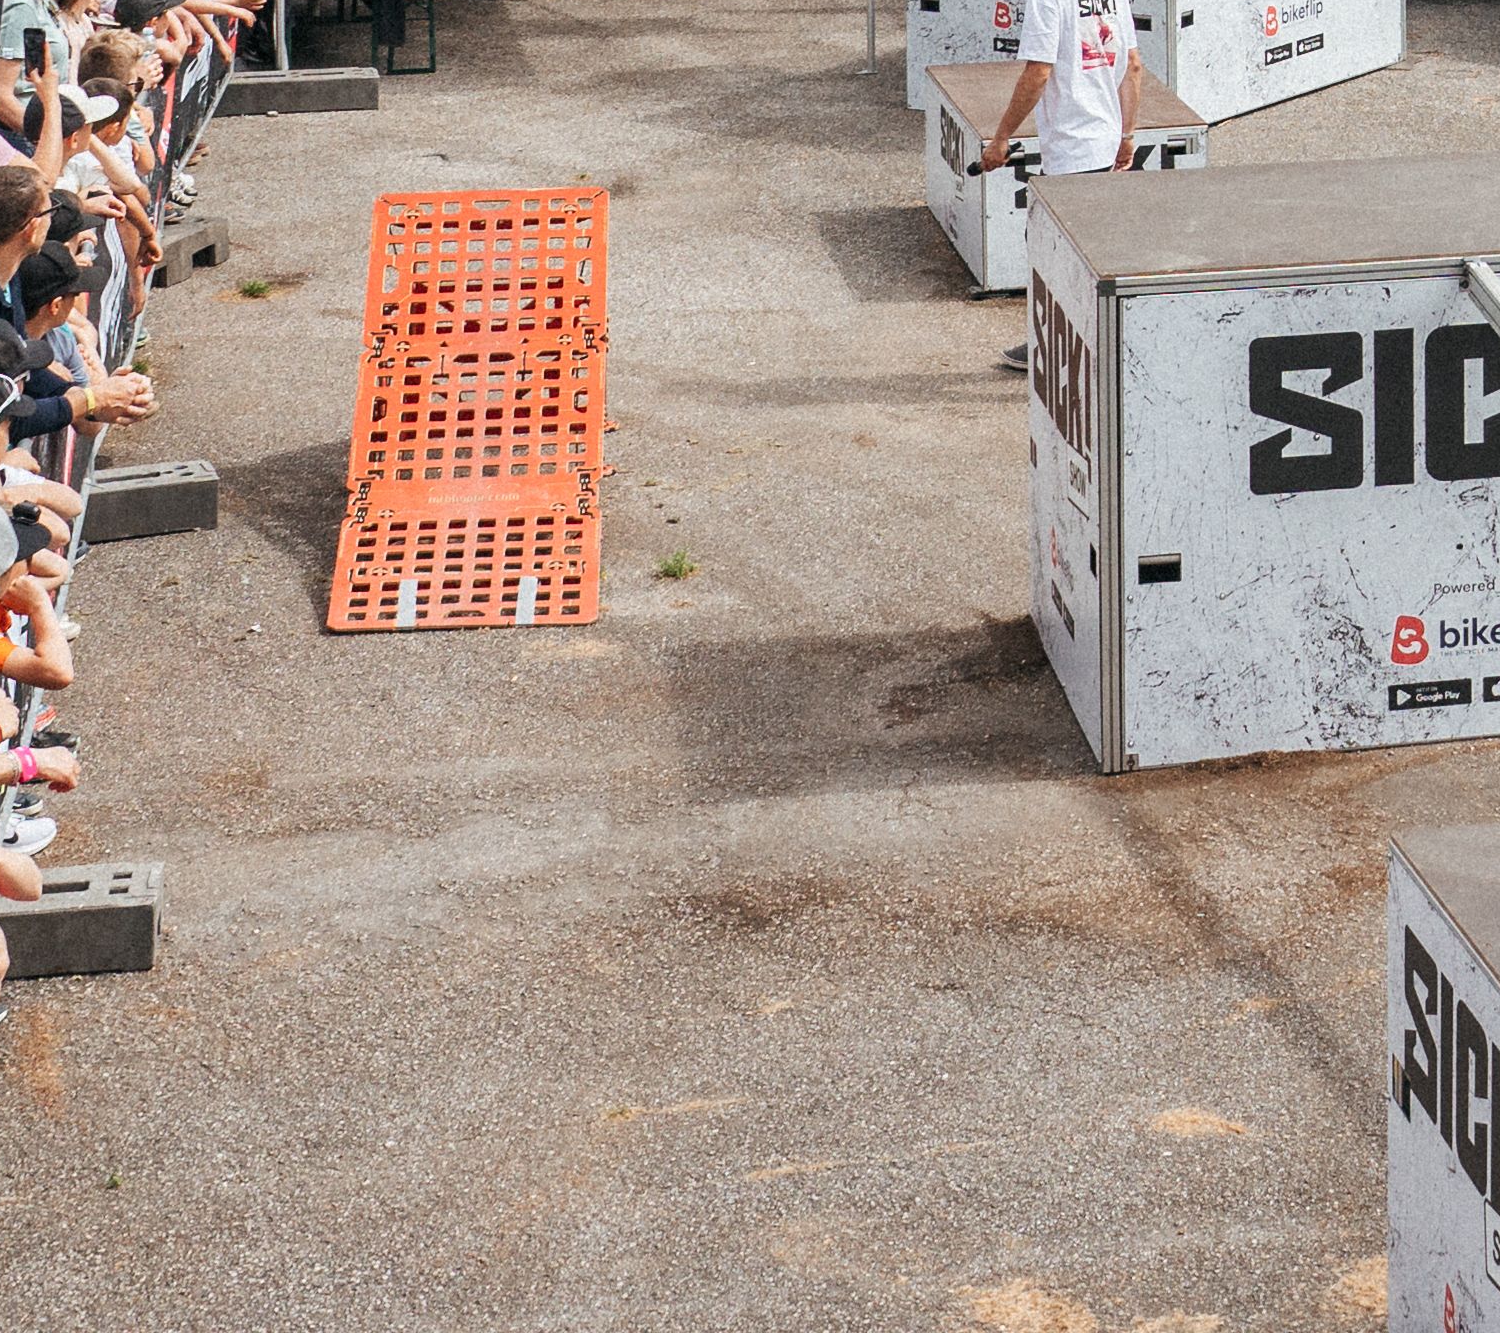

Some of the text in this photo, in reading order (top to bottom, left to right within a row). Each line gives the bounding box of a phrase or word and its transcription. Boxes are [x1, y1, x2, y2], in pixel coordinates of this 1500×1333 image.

[1032, 267, 1091, 485] SICK!
[1433, 578, 1496, 596] Powered
[1415, 690, 1461, 703] Google Play
